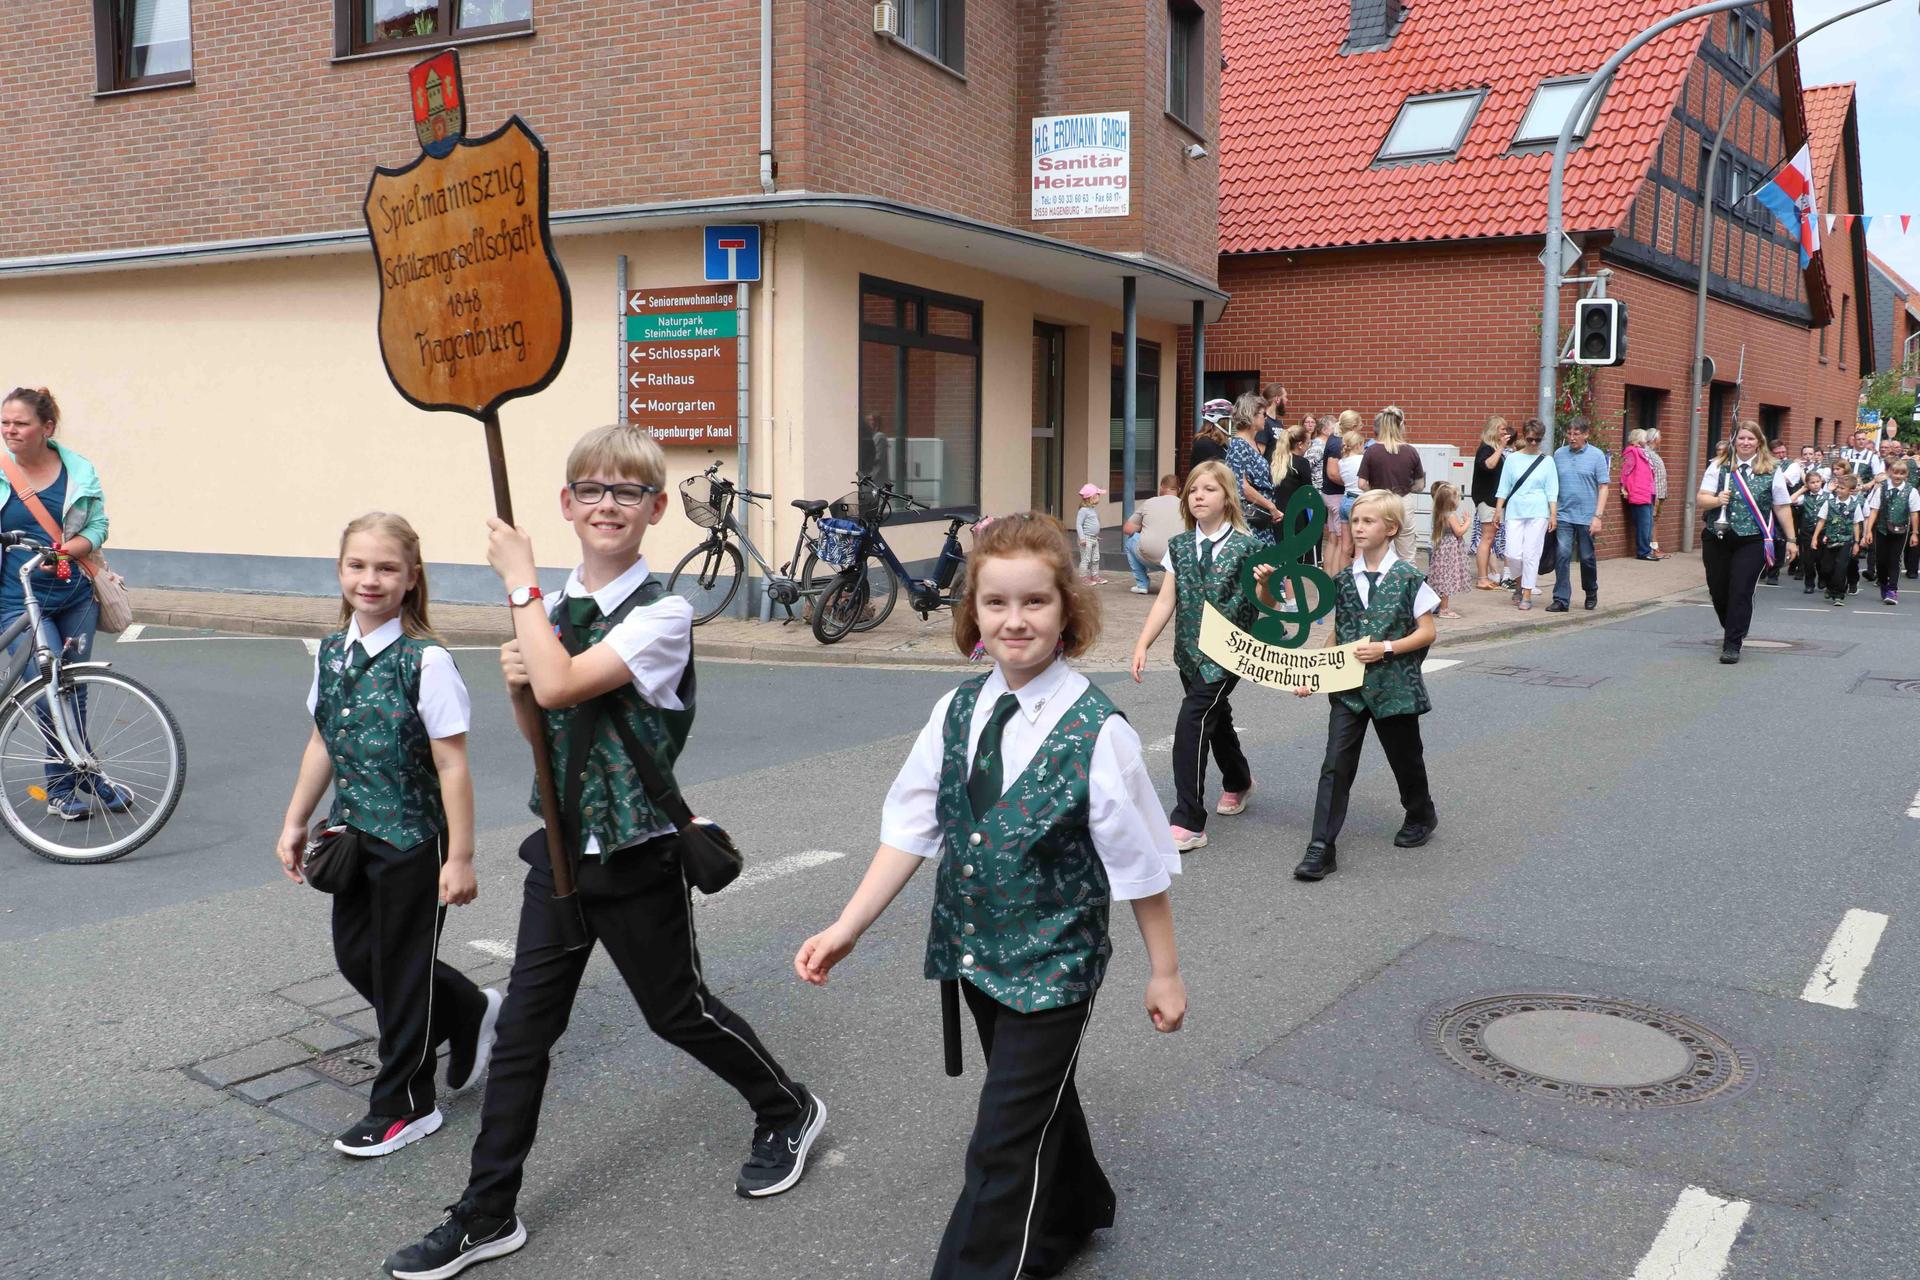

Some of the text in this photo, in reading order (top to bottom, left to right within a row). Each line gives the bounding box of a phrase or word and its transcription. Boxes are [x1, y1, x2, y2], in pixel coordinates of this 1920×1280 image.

[1054, 117, 1098, 149] ERDMANN
[1101, 117, 1127, 150] GMBH
[1038, 153, 1123, 171] Sanitär
[1033, 174, 1127, 190] Heizung
[379, 159, 526, 241] Spielmannszug
[446, 287, 483, 319] 1848
[648, 293, 733, 308] Seniorenwohnanlage
[658, 315, 704, 327] Naturpark
[644, 327, 718, 339] Steinhuder Meer
[648, 345, 721, 361] Schlosspark
[648, 374, 695, 386] Rathaus
[648, 399, 716, 414] Moorgarten
[648, 424, 733, 441] Hagenburger Kanal
[1225, 630, 1346, 670] Spielmannszug
[1235, 654, 1321, 693] Hagenburg
